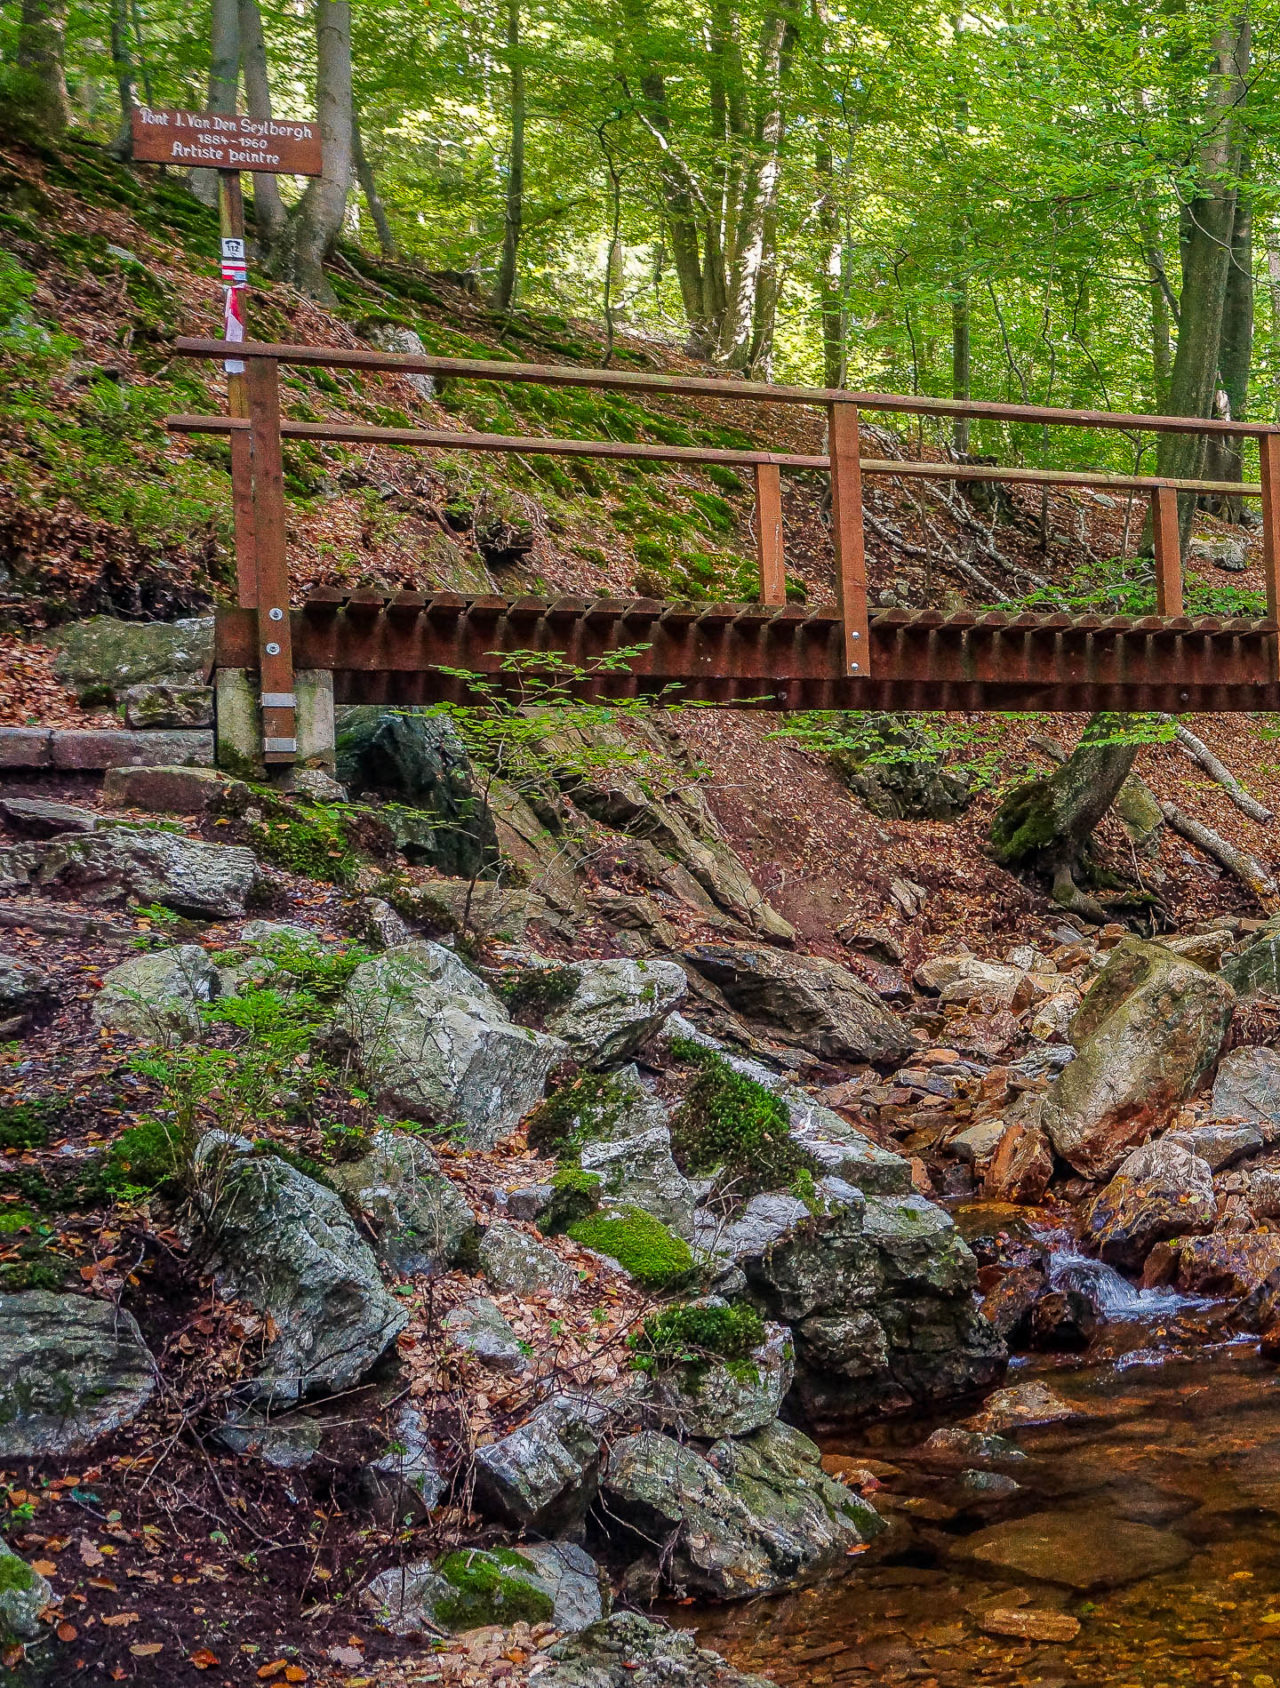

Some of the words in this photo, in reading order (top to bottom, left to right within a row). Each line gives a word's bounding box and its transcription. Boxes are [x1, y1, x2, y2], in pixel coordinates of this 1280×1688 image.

[139, 108, 169, 126] Pont
[187, 113, 211, 129] Van
[213, 116, 237, 132] Den
[240, 118, 313, 141] Seylbergh
[171, 141, 224, 160] Artiste
[229, 149, 280, 165] peintre
